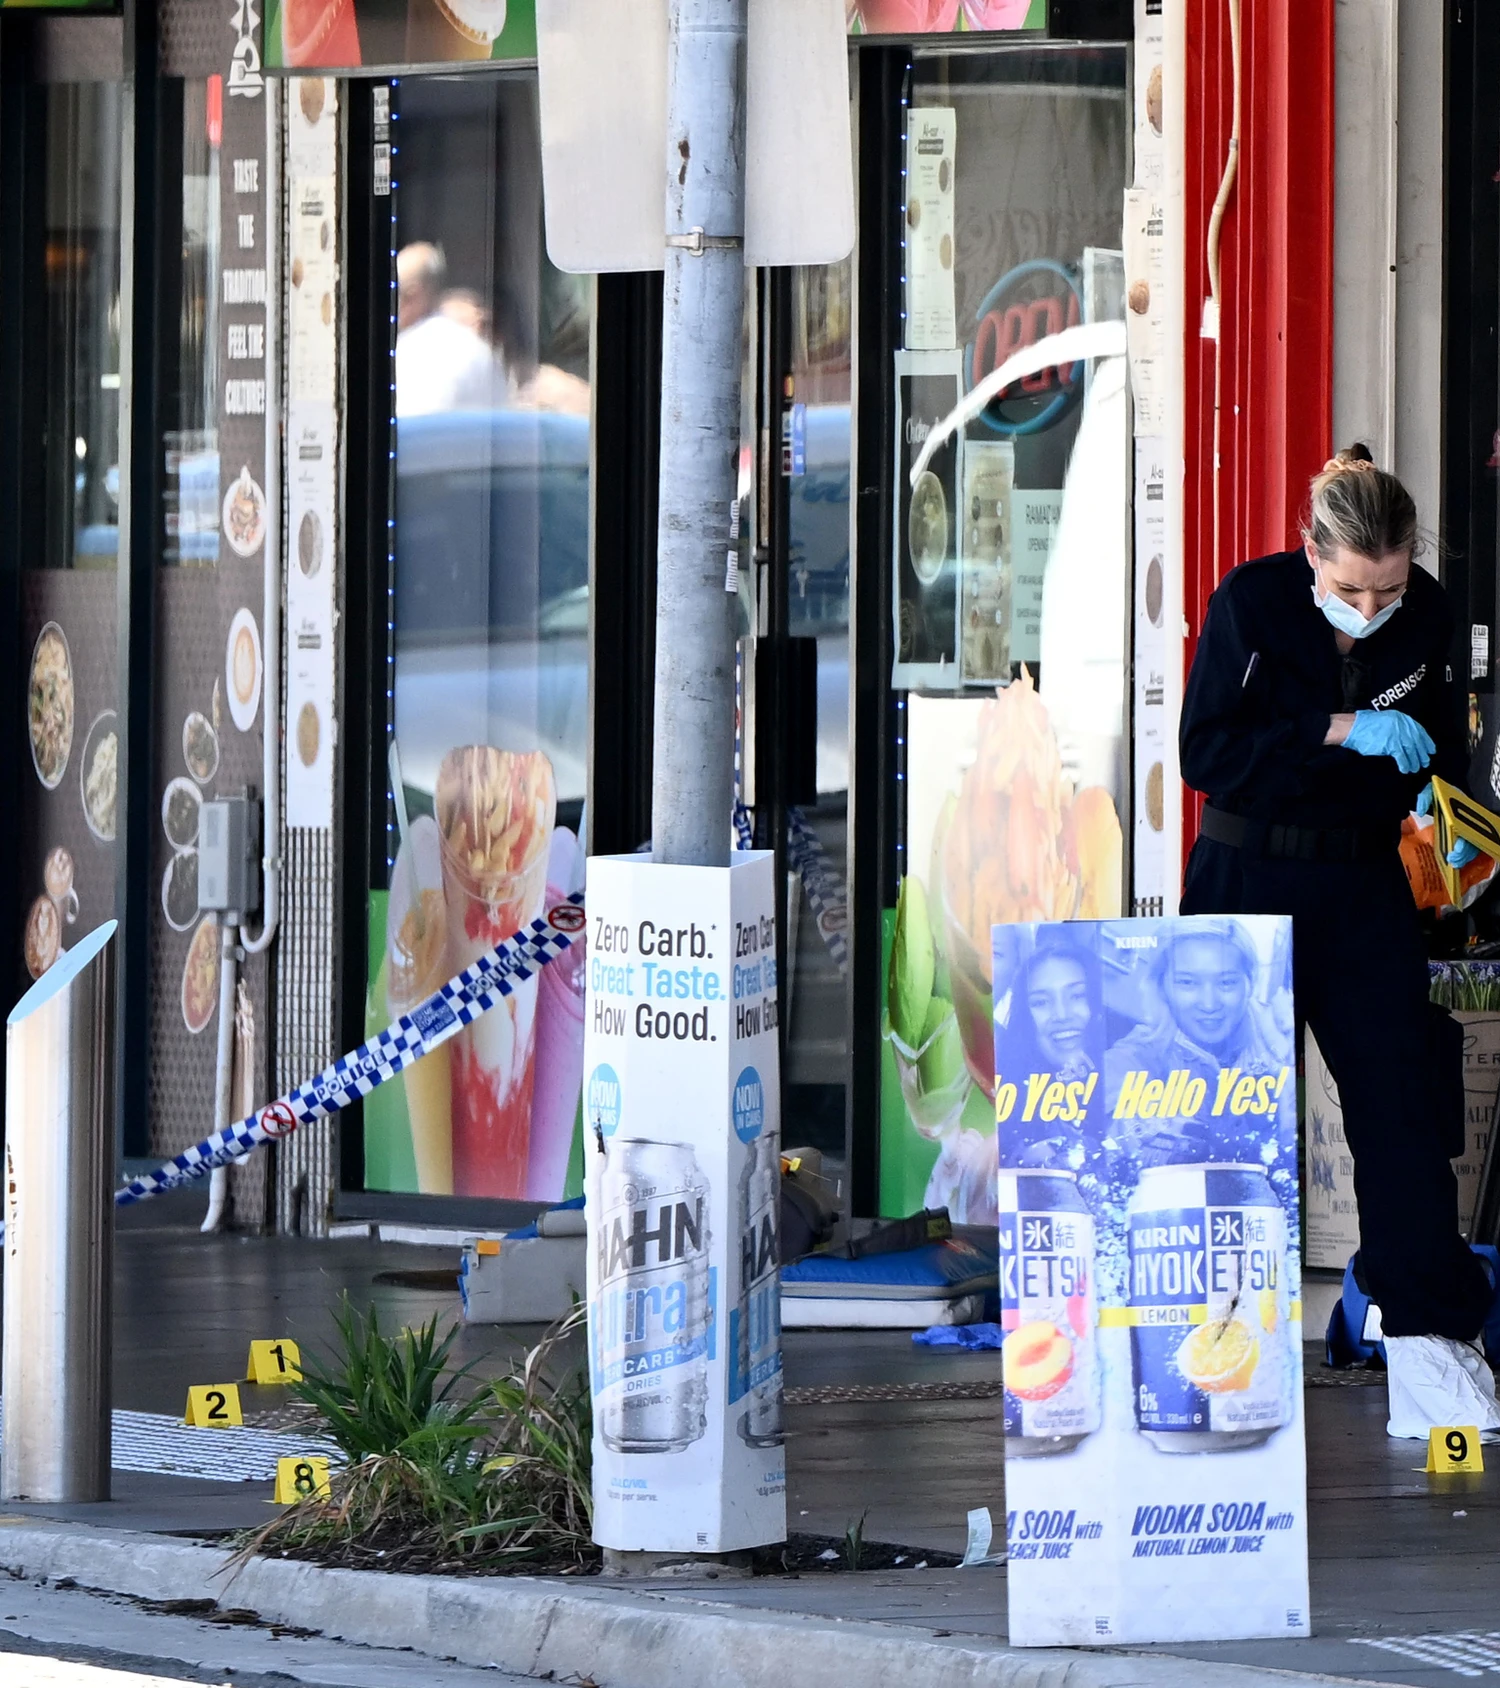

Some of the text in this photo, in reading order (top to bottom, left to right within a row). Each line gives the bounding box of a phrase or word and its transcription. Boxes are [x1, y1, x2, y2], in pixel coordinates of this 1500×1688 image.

[233, 159, 259, 193] TASTE
[595, 916, 629, 954] Zero
[735, 921, 757, 958] Zero
[1115, 936, 1158, 949] KIRIN
[466, 944, 536, 998] POLICE
[591, 957, 727, 1001] Great Taste.
[733, 963, 762, 999] Great
[594, 999, 718, 1042] How Good.
[736, 1004, 761, 1040] How
[316, 1050, 386, 1101] POLICE
[591, 1080, 618, 1107] NOW
[735, 1082, 761, 1112] NOW
[1022, 1072, 1099, 1122] Yes!
[1112, 1066, 1290, 1120] Hello Yes!
[597, 1196, 705, 1286] HAHN
[1023, 1216, 1076, 1249] 氷結
[1133, 1225, 1201, 1249] KIRIN
[1214, 1214, 1267, 1245] 氷結
[1134, 1249, 1278, 1297] HYOKETSU
[1141, 1308, 1190, 1324] LEMON
[270, 1345, 286, 1372] 1
[623, 1353, 676, 1373] CARB
[205, 1391, 229, 1419] 2
[1139, 1384, 1158, 1413] 6%
[1445, 1431, 1468, 1462] 9
[294, 1463, 316, 1494] 8
[1019, 1509, 1103, 1540] SODA with
[1131, 1501, 1295, 1536] VODKA SODA with
[1039, 1541, 1074, 1560] JUICE
[1132, 1534, 1266, 1558] NATURAL LEMON JUICE
